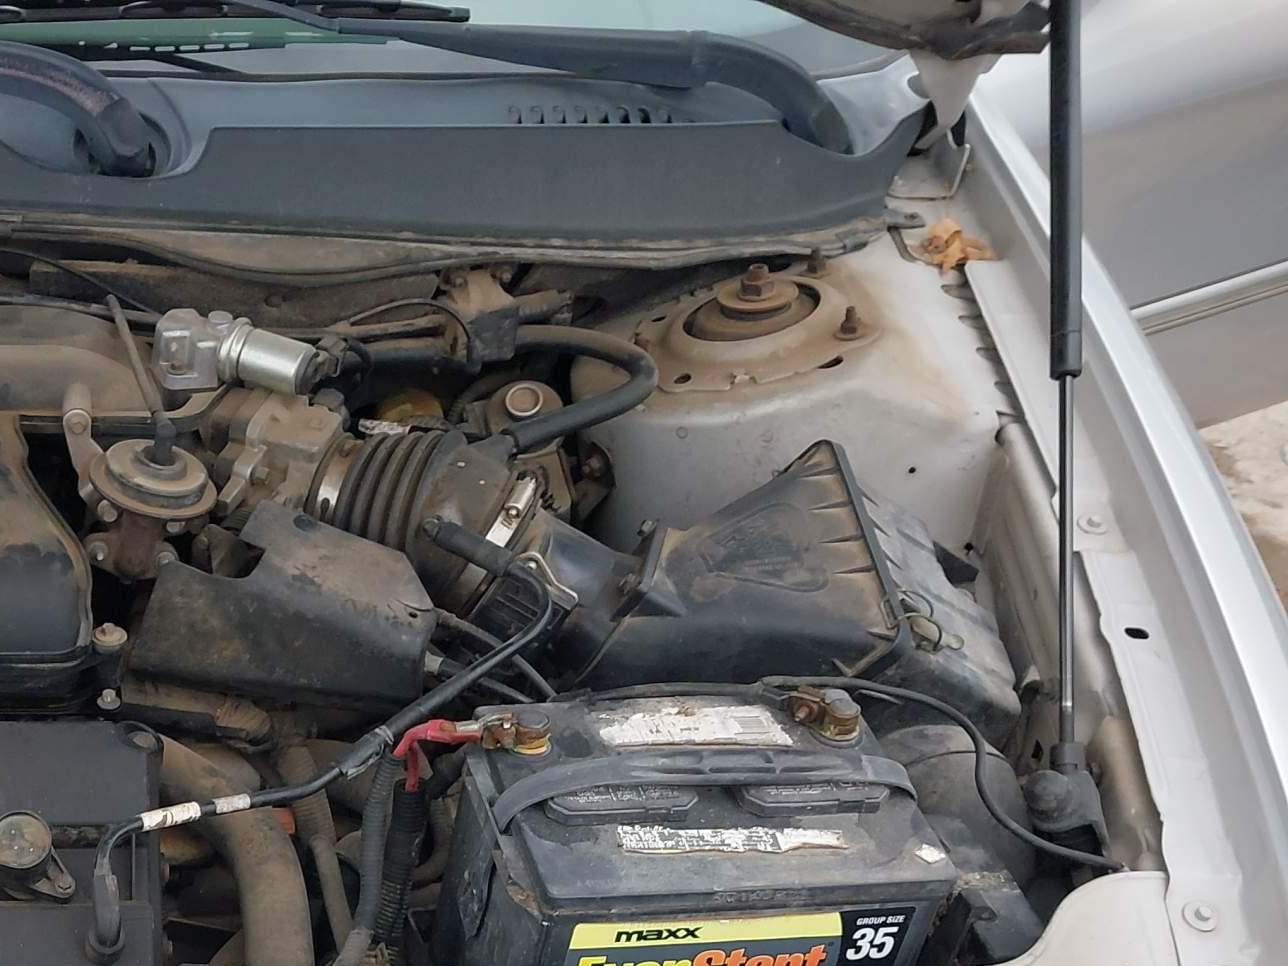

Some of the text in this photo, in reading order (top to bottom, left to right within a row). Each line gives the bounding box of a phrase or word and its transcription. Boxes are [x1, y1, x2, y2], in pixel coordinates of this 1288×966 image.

[856, 915, 906, 926] GROUP SIZE
[614, 927, 703, 943] maxx
[846, 926, 900, 961] 35
